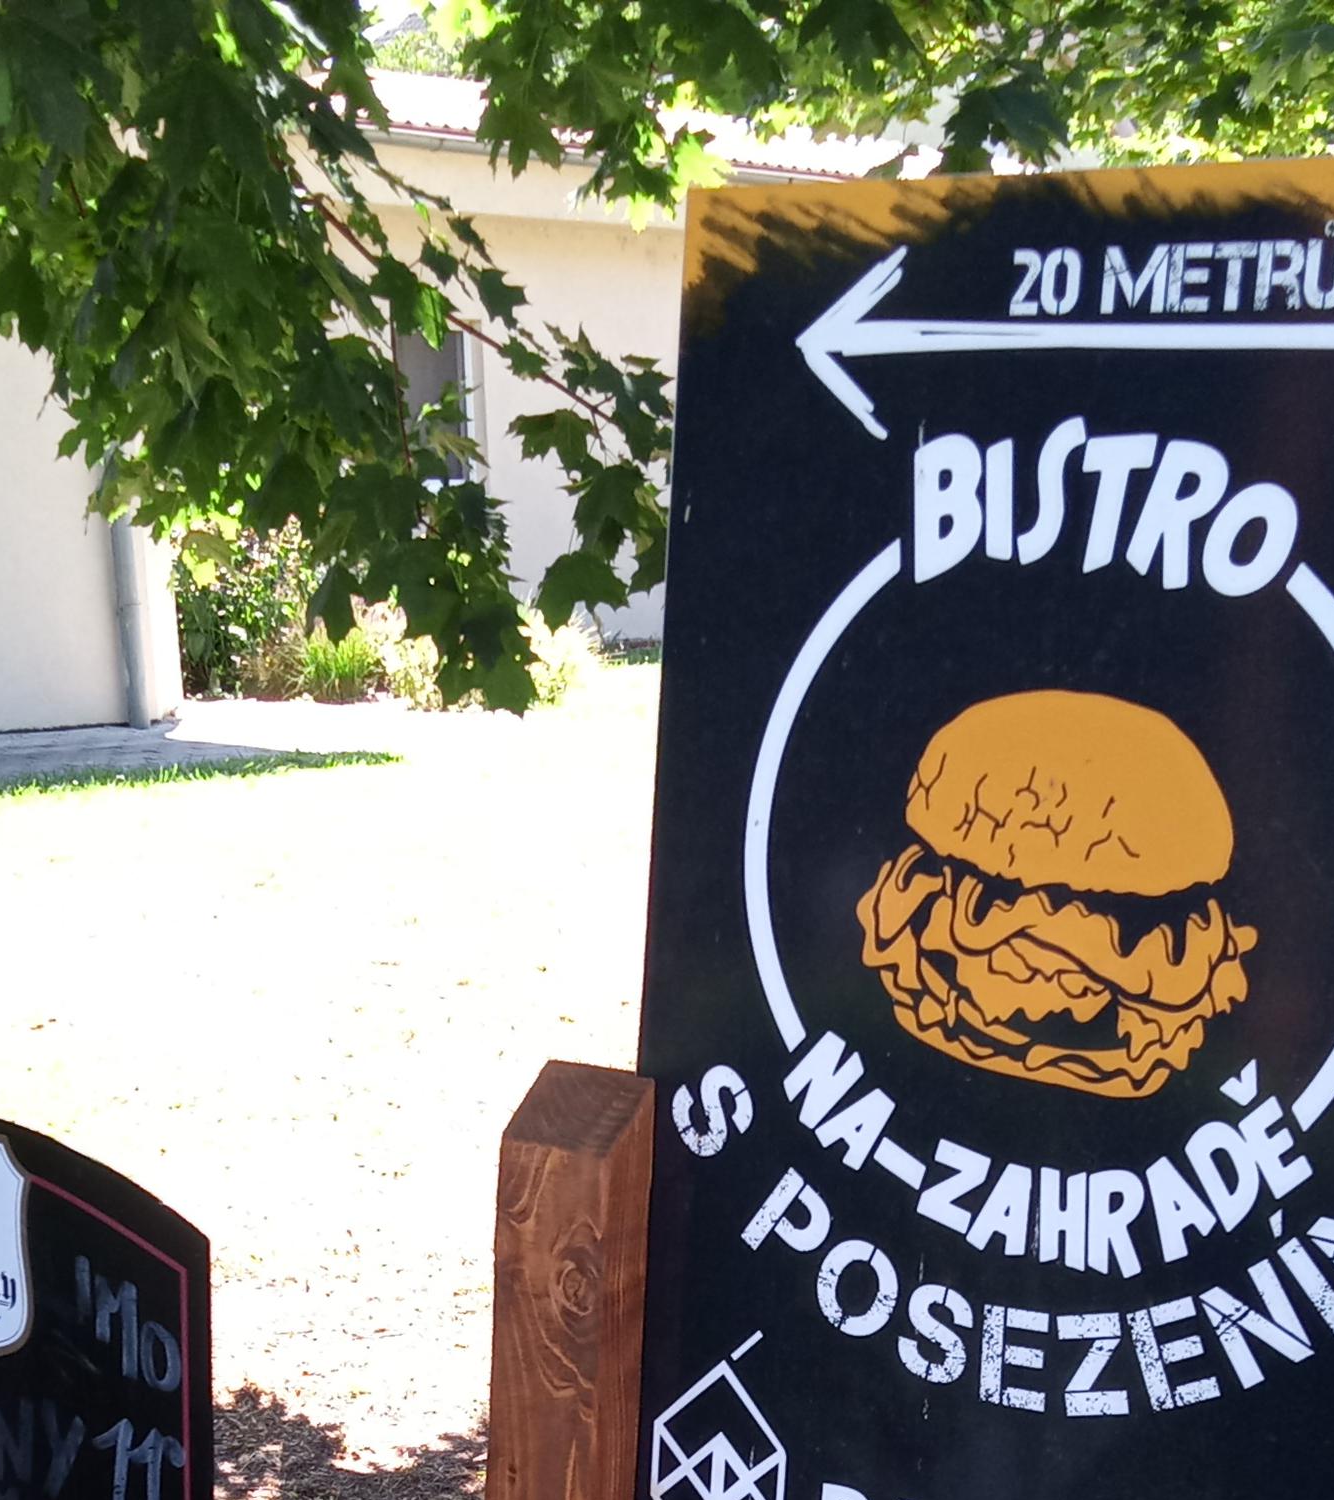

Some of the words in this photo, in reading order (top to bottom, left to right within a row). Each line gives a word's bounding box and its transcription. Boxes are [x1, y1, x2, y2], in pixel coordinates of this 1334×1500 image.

[1008, 248, 1081, 316] 20
[914, 416, 1299, 598] BISTRO
[672, 1064, 754, 1157] S
[782, 1030, 1314, 1278] NA-ZAHRADĚ
